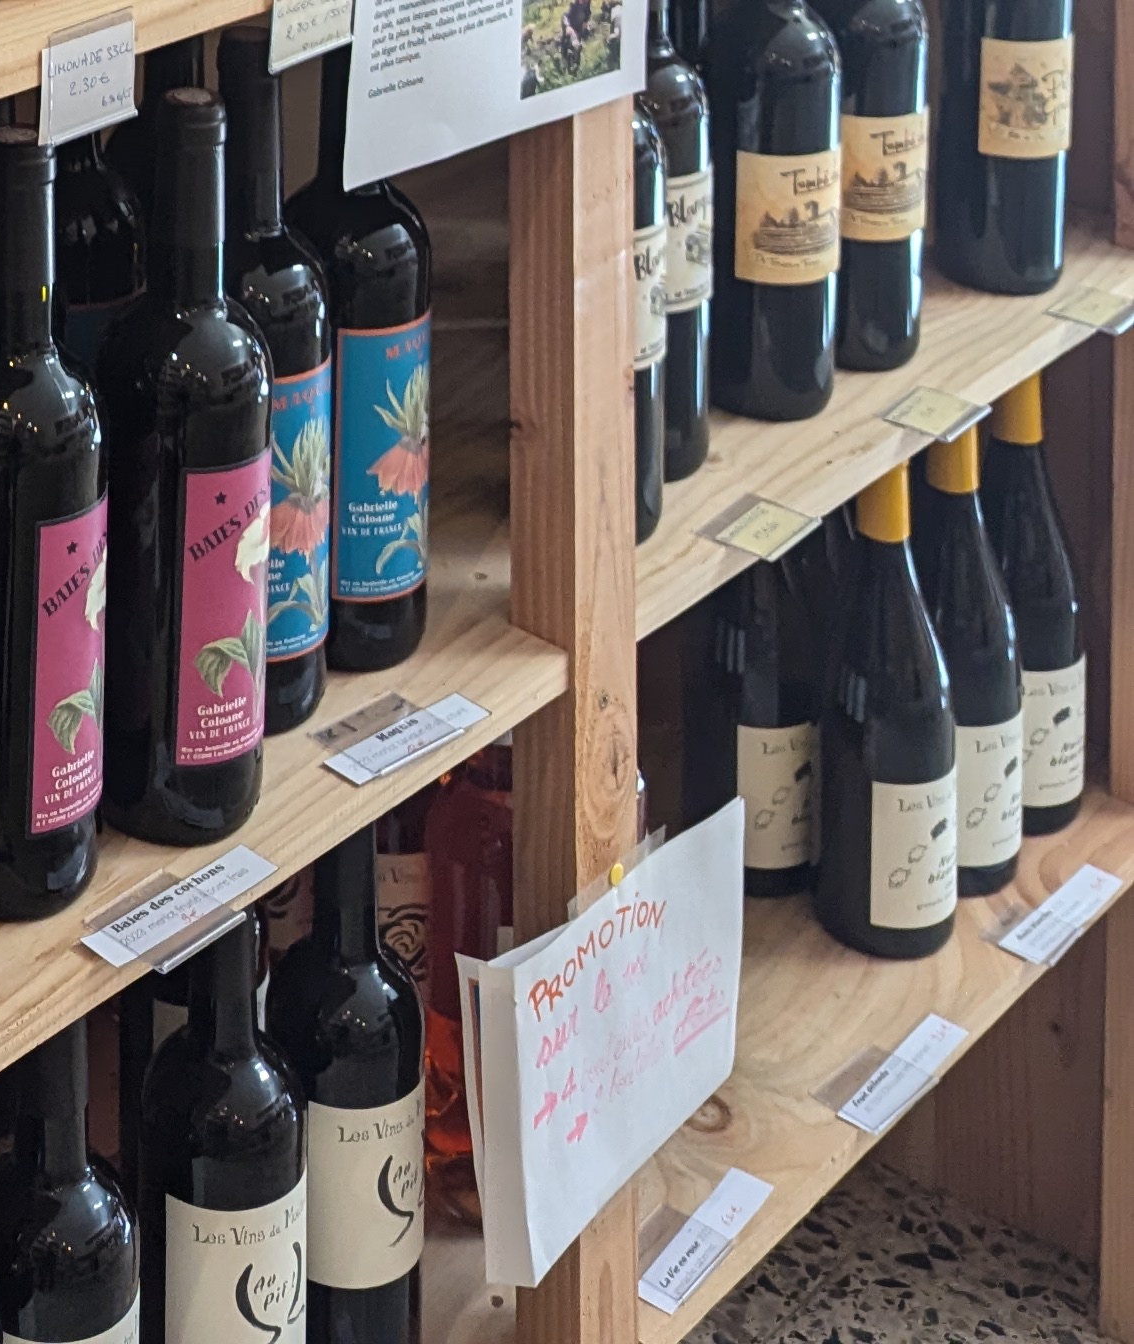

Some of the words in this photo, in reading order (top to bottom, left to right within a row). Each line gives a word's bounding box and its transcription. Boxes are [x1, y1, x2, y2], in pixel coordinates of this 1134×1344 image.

[348, 499, 398, 513] Gabrielle
[351, 512, 396, 525] Coloane
[188, 513, 243, 562] BAIES
[42, 559, 92, 616] BAIES
[197, 696, 247, 716] Gabrielle
[200, 710, 245, 728] Coloane
[51, 749, 95, 779] Gabrielle
[54, 764, 92, 790] Coloane
[110, 910, 150, 934] Baies
[149, 893, 174, 911] des
[174, 862, 225, 896] cochons
[529, 892, 667, 1021] PROMOTION
[192, 1224, 226, 1245] Les
[230, 1218, 265, 1246] Vins
